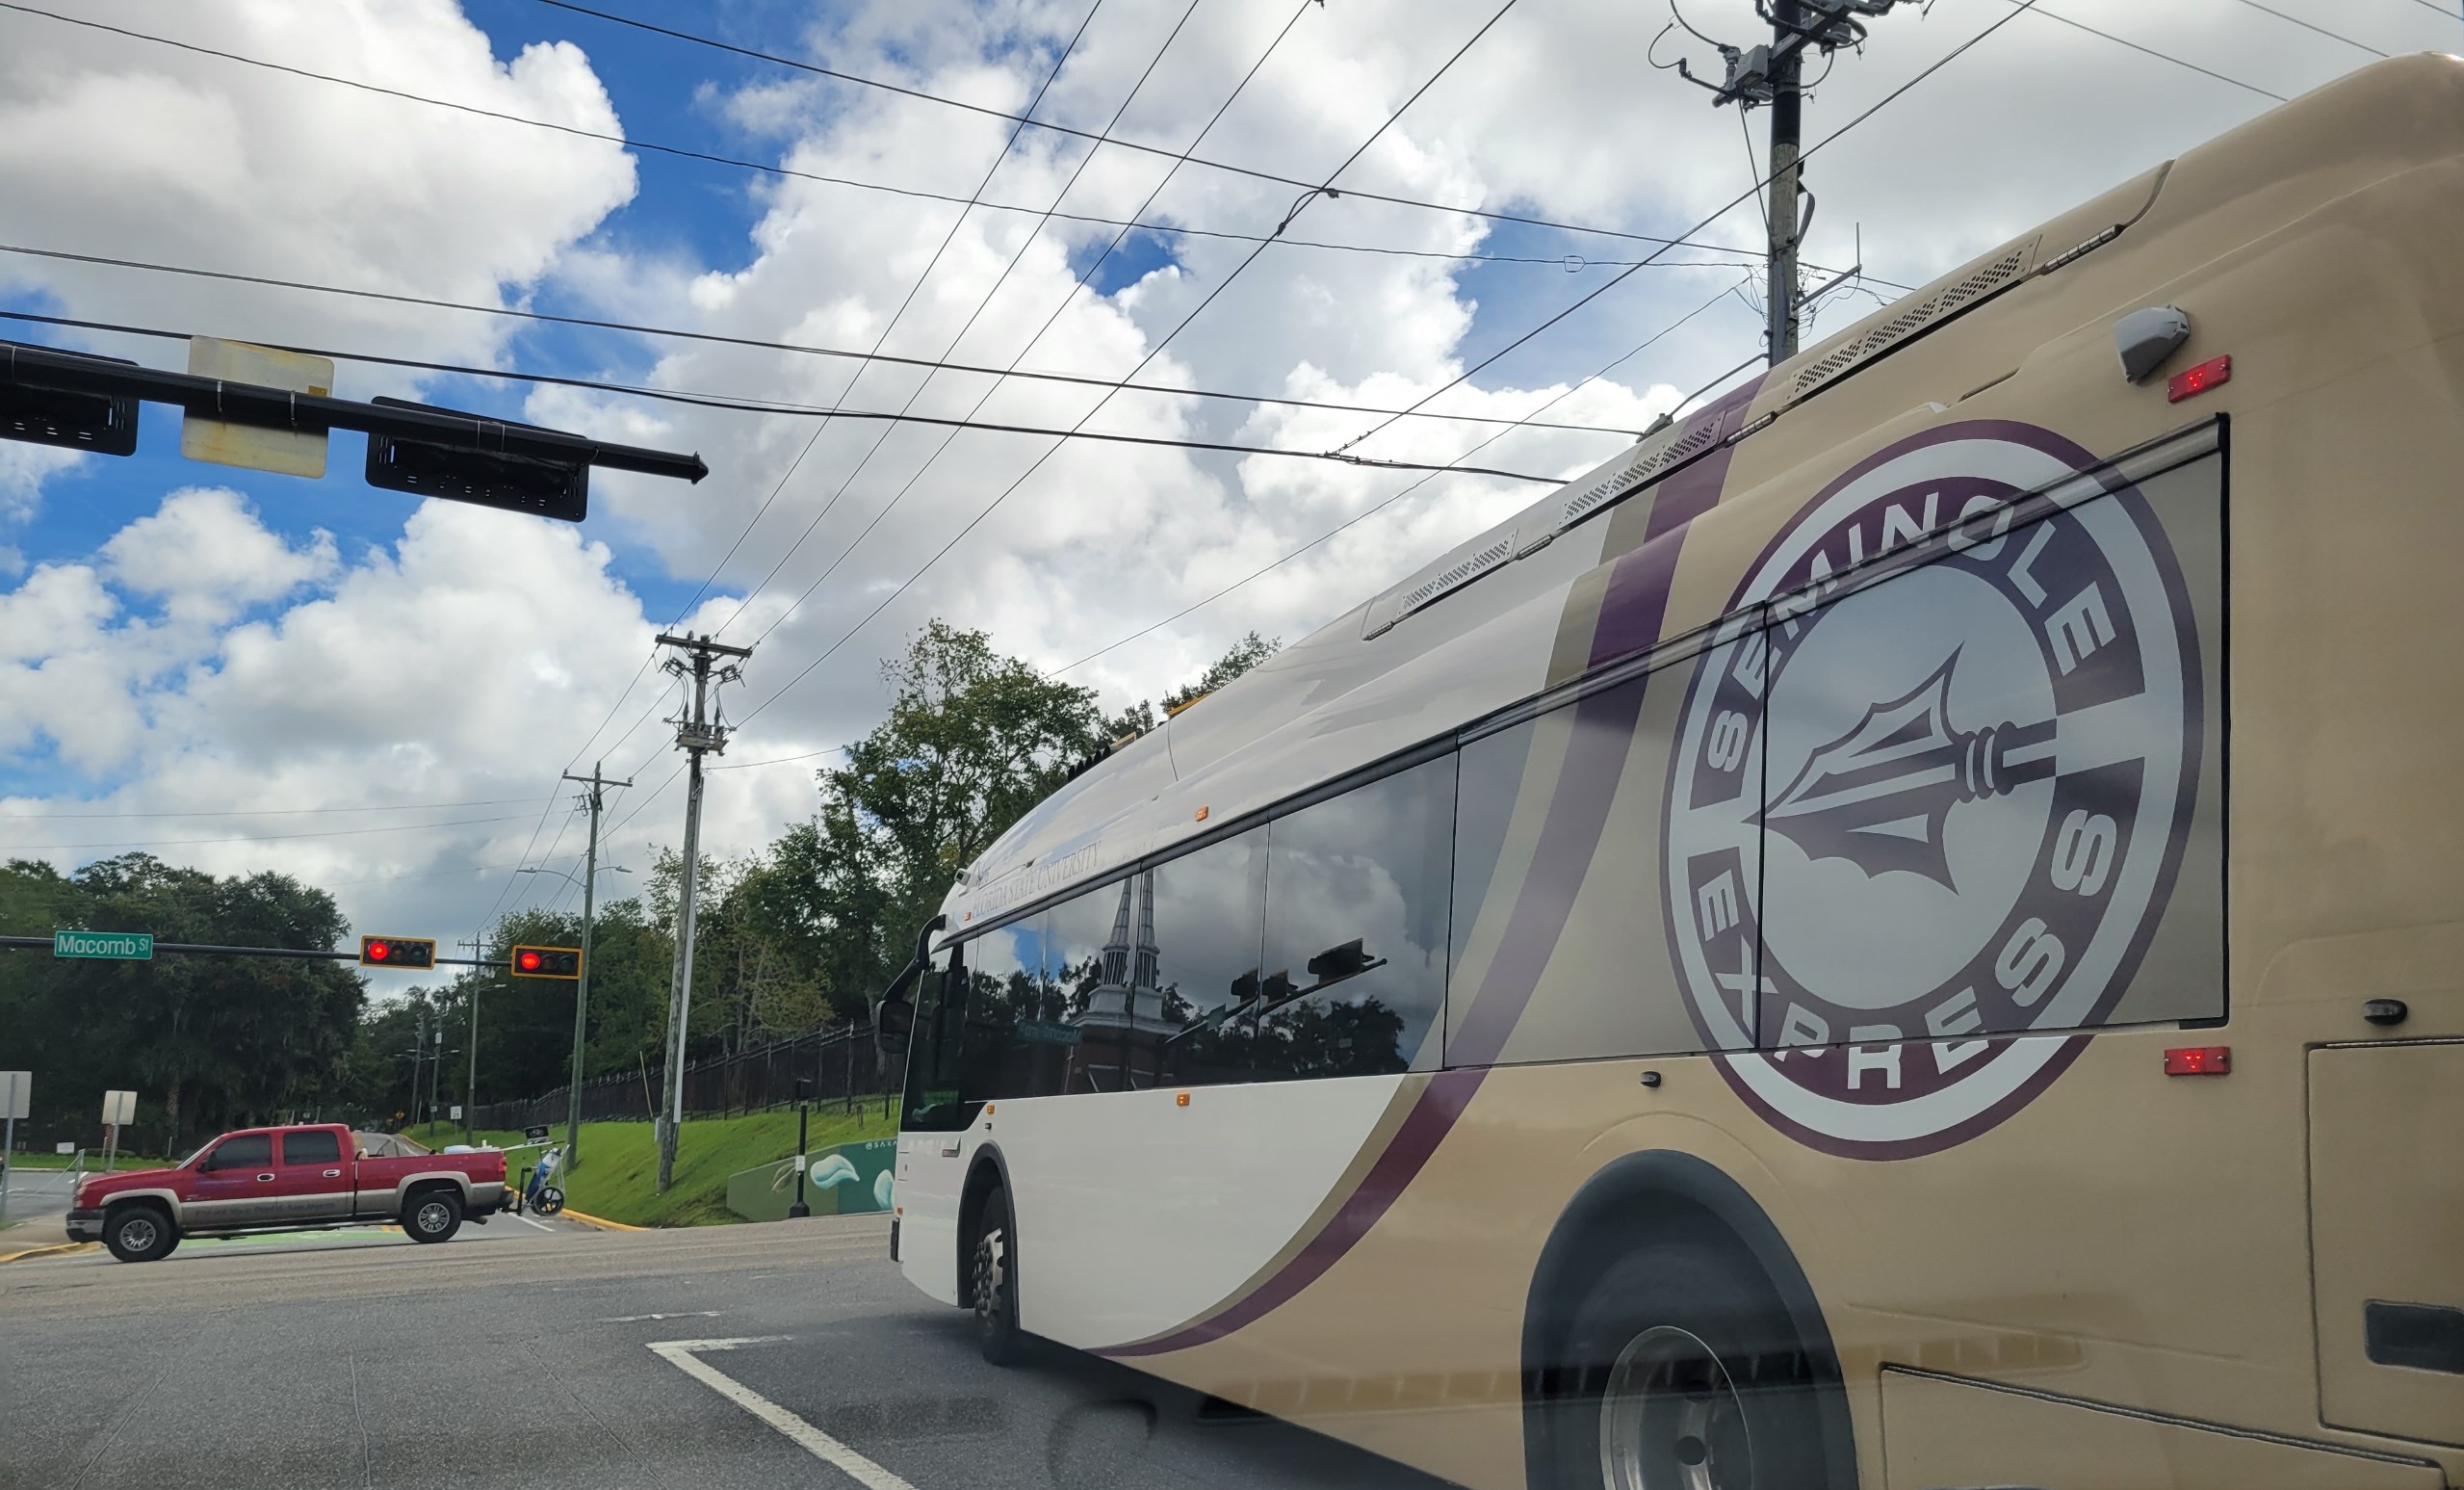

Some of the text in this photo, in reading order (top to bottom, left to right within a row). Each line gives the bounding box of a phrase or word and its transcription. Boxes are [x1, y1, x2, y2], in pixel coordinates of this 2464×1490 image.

[1707, 491, 2116, 773] SEMINOLE
[59, 935, 149, 955] Macomb St
[973, 840, 1102, 919] FLORIDA STATE UNIVERSITY
[1699, 808, 2118, 1091] EXPRESS
